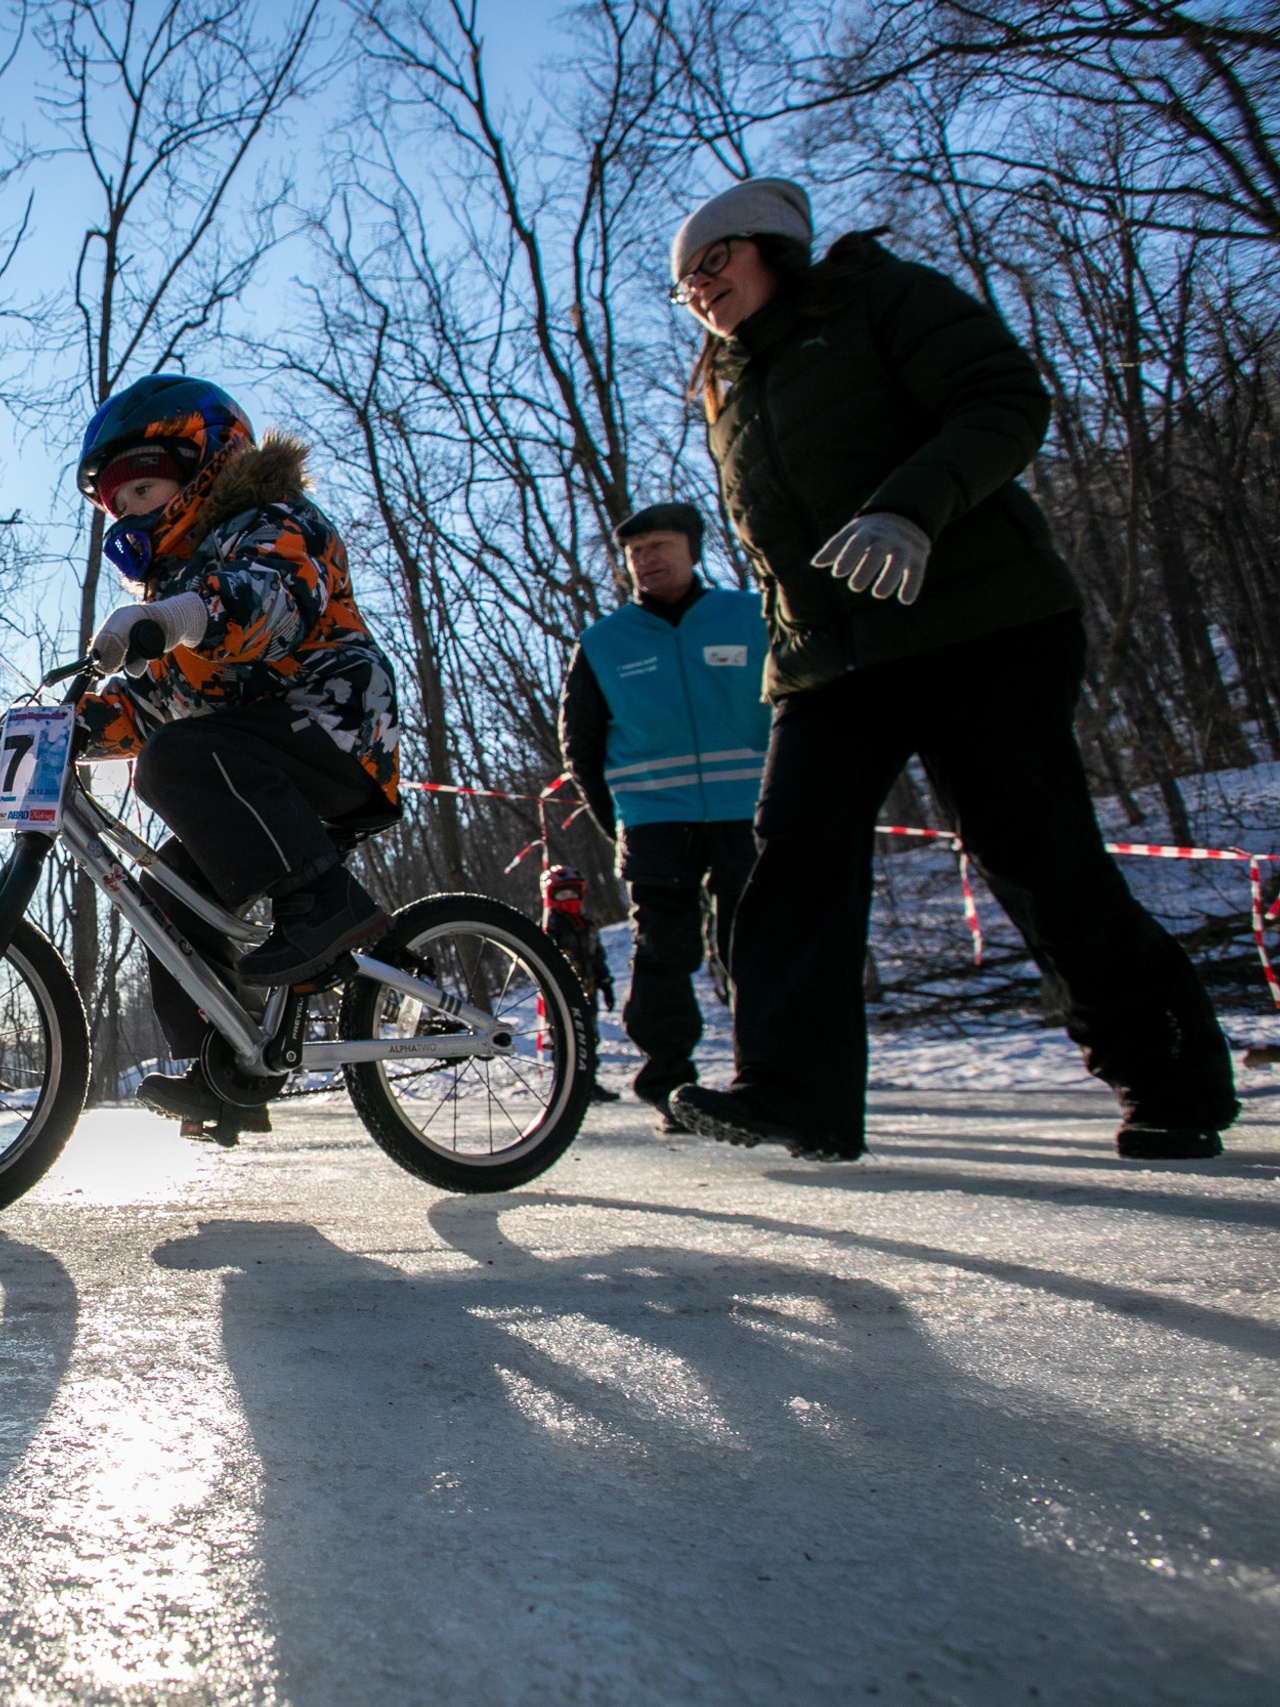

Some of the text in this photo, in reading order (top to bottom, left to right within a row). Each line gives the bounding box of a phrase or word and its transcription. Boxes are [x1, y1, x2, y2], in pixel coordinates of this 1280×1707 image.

[3, 735, 35, 792] 7
[389, 1043, 437, 1054] ALPHATWO
[570, 1007, 587, 1071] KENDA
